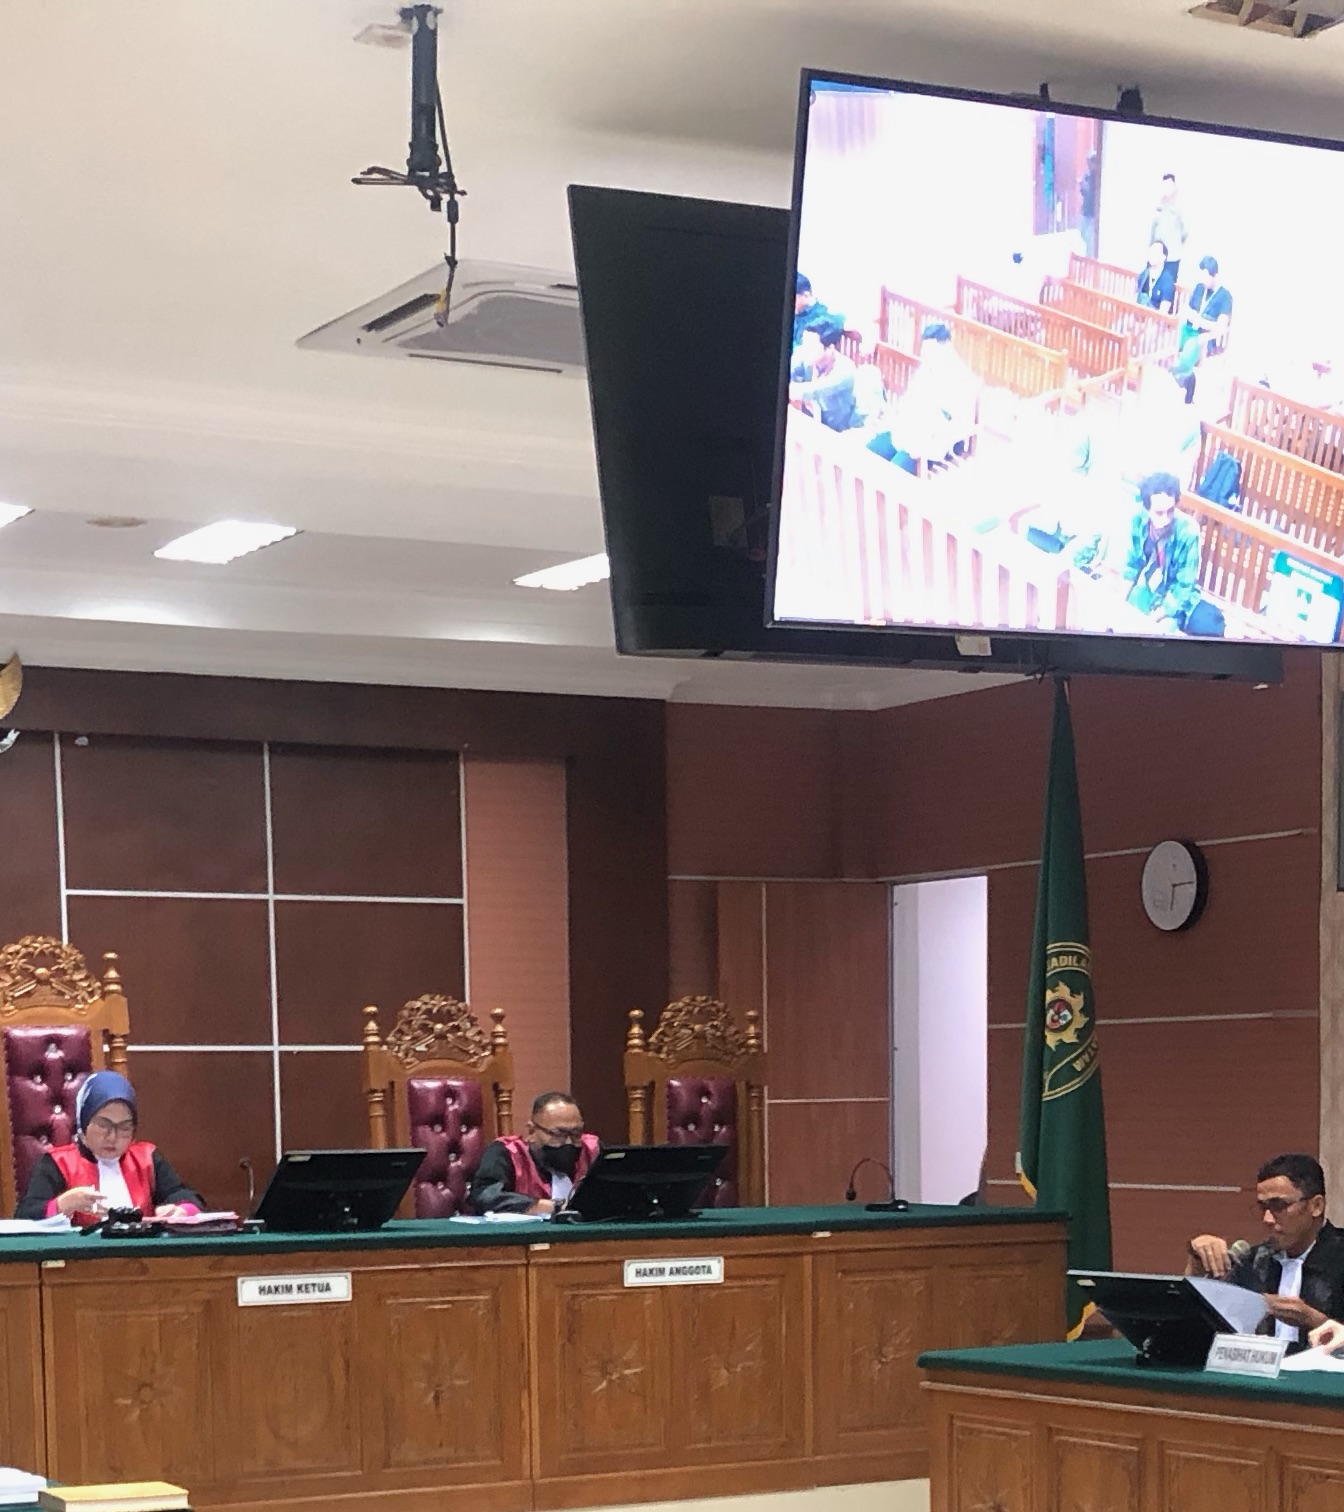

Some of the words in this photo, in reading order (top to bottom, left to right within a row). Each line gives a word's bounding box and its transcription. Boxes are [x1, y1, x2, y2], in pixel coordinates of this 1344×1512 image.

[635, 1267, 666, 1278] HAKIM
[668, 1264, 713, 1277] ANGGOTA
[258, 1284, 293, 1296] HAKIM
[296, 1281, 332, 1294] KETUA
